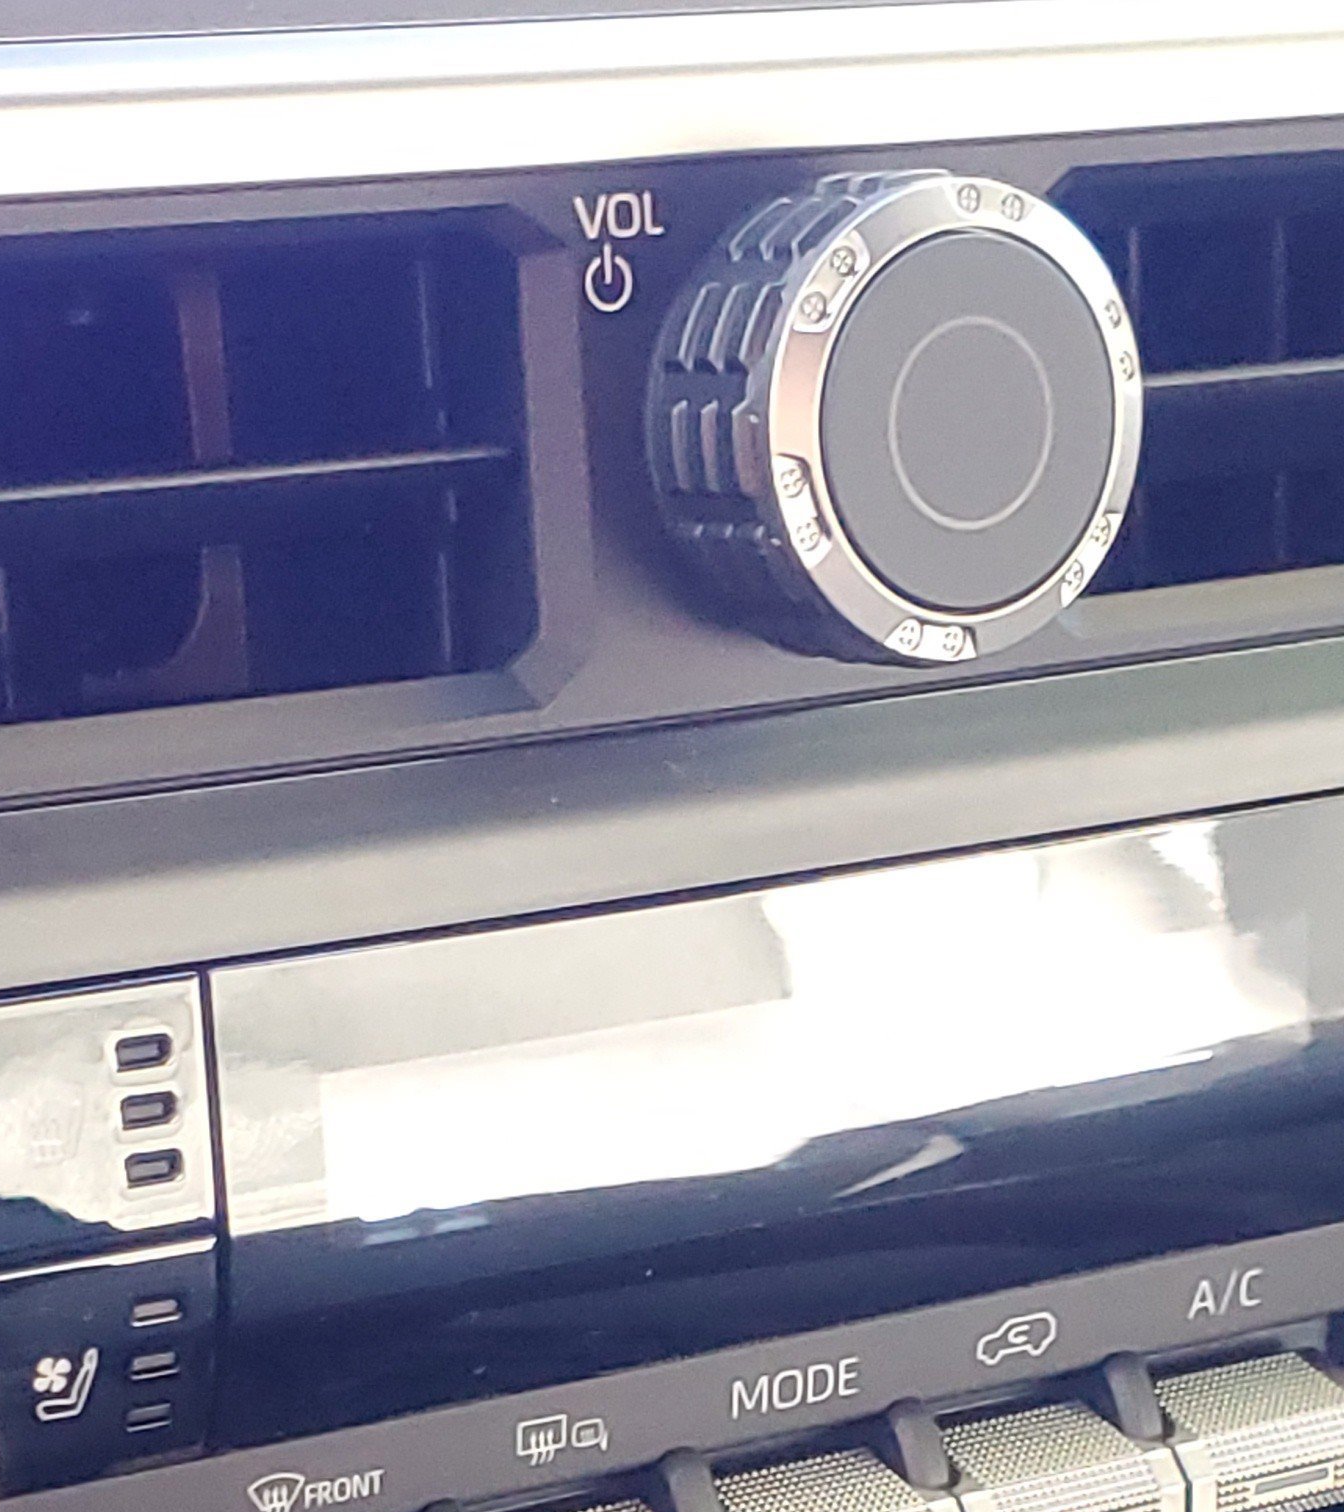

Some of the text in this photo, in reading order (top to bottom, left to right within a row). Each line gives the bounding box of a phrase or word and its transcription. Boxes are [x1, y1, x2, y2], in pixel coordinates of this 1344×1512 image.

[574, 192, 664, 240] VOL
[1187, 1268, 1263, 1320] A/C
[731, 1355, 861, 1421] MODE
[304, 1468, 385, 1510] FRONT
